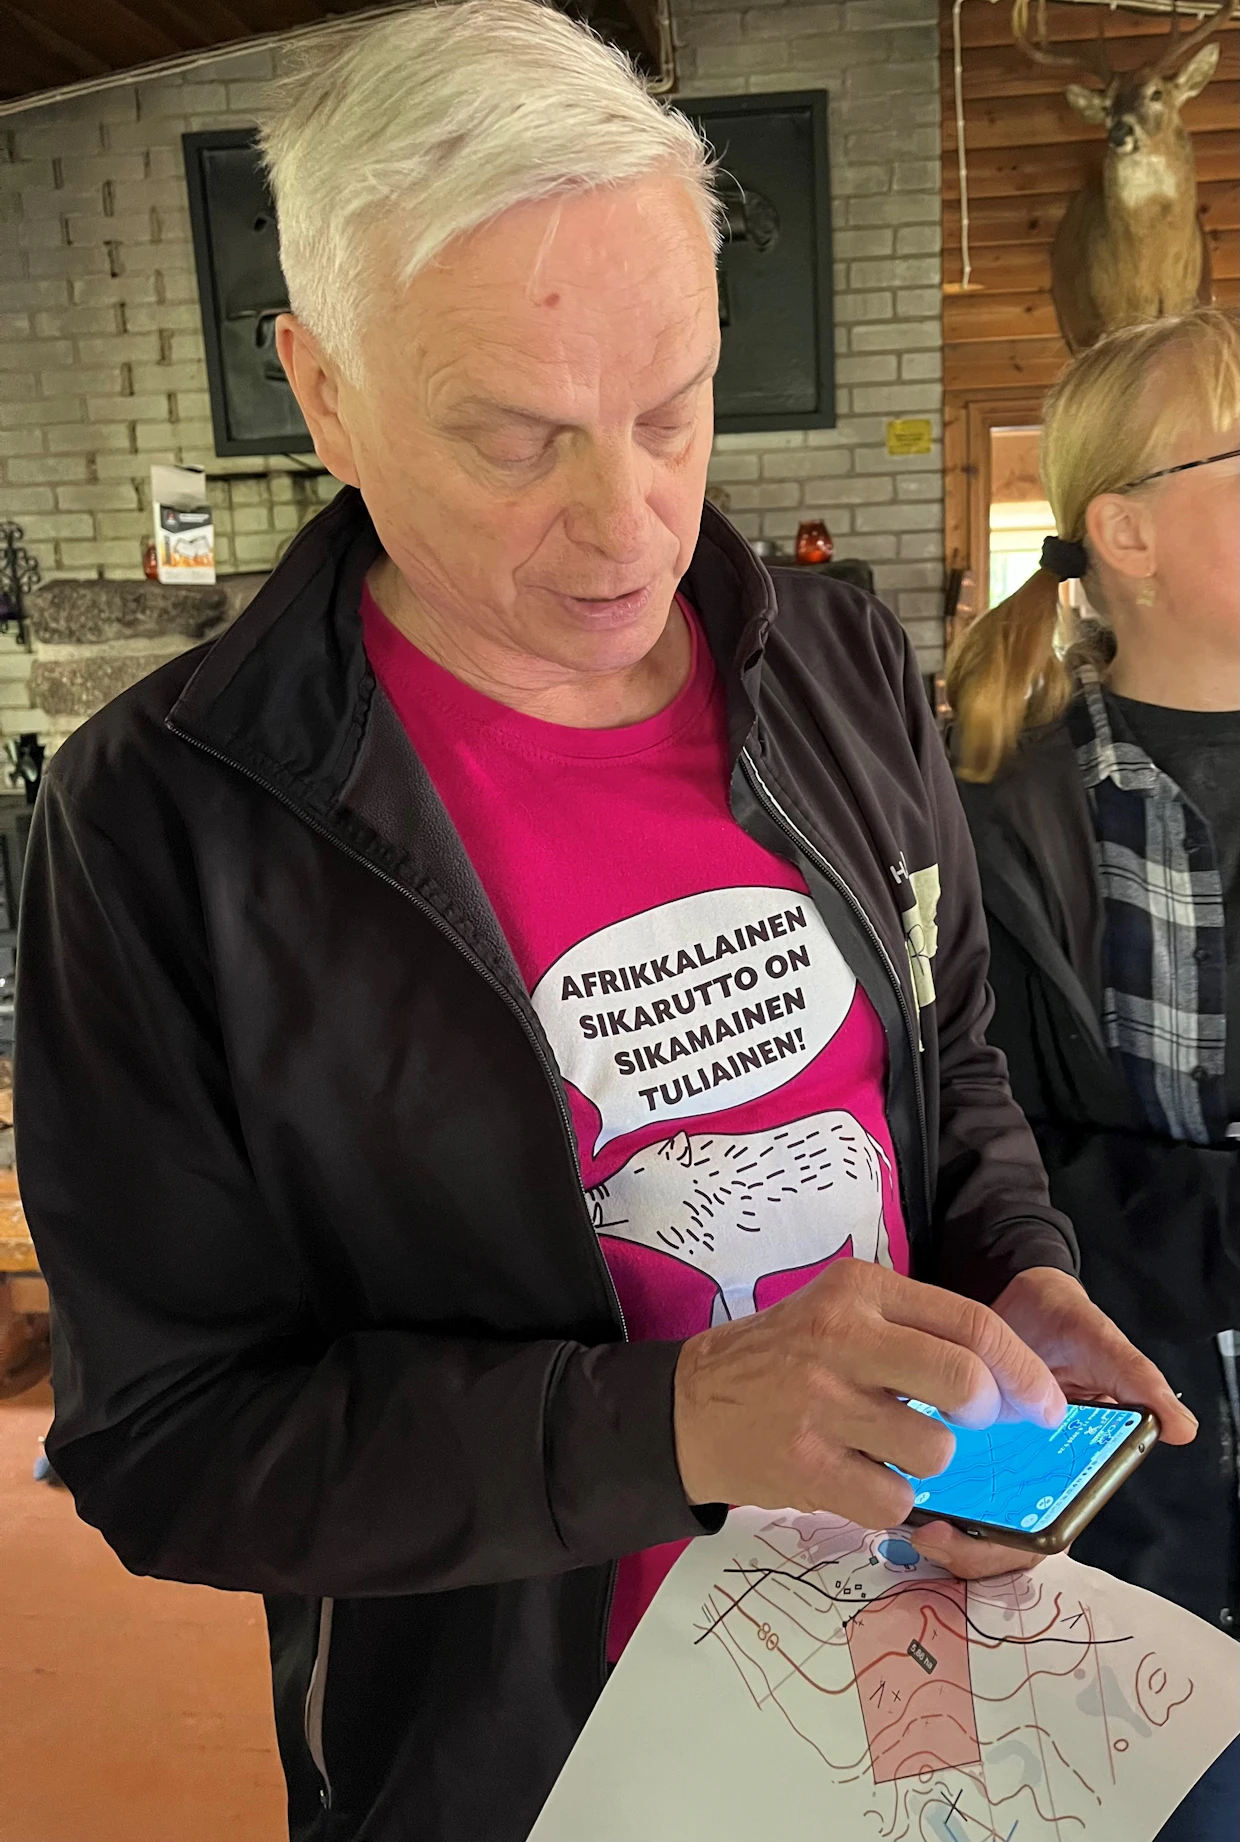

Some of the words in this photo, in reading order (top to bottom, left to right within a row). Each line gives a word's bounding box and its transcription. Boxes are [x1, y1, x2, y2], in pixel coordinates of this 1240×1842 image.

[562, 906, 806, 1000] AFRIKKALAINEN
[580, 967, 758, 1039] SIKARUTTO
[765, 945, 810, 978] ON
[615, 987, 805, 1075] SIKAMAINEN
[639, 1028, 805, 1111] TULIAINEN!
